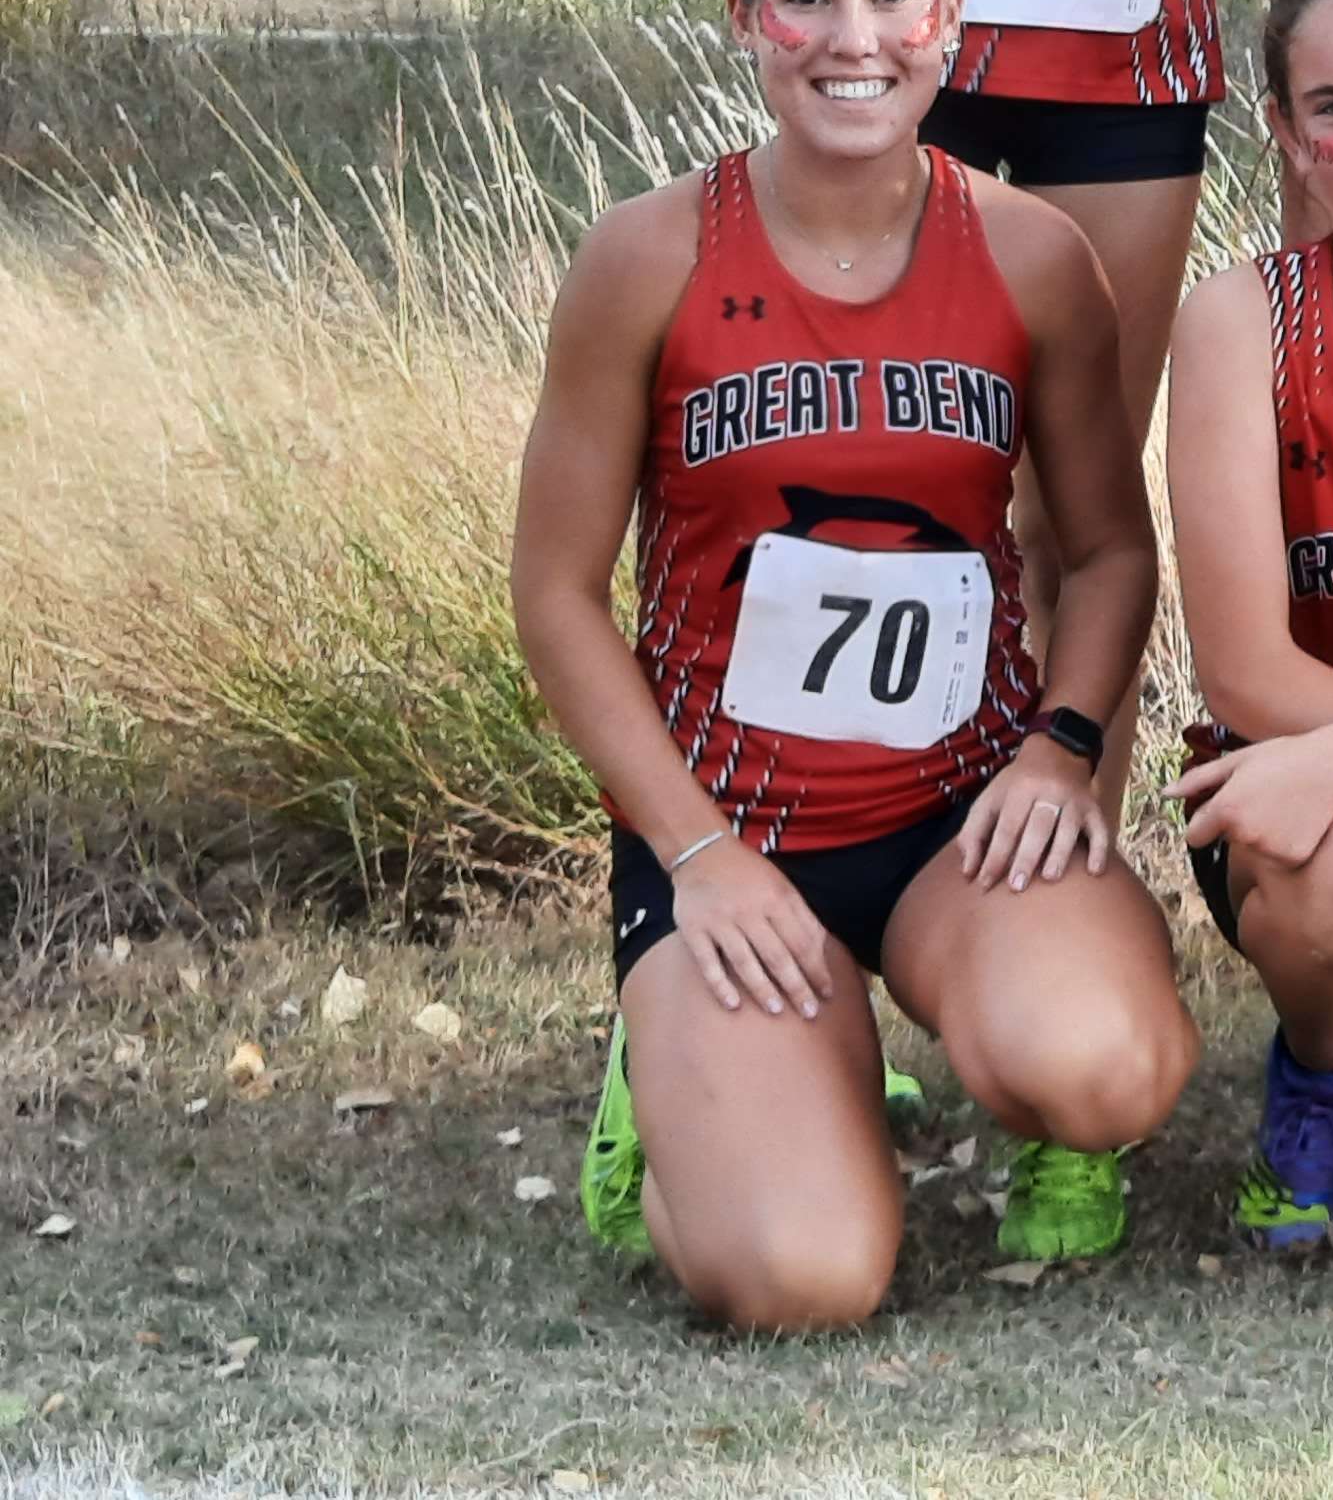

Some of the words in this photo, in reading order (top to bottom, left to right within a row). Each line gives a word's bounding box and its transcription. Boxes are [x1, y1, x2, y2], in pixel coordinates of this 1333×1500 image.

[682, 359, 864, 468] GREAT
[881, 359, 1015, 457] BEND
[801, 594, 930, 705] 70
